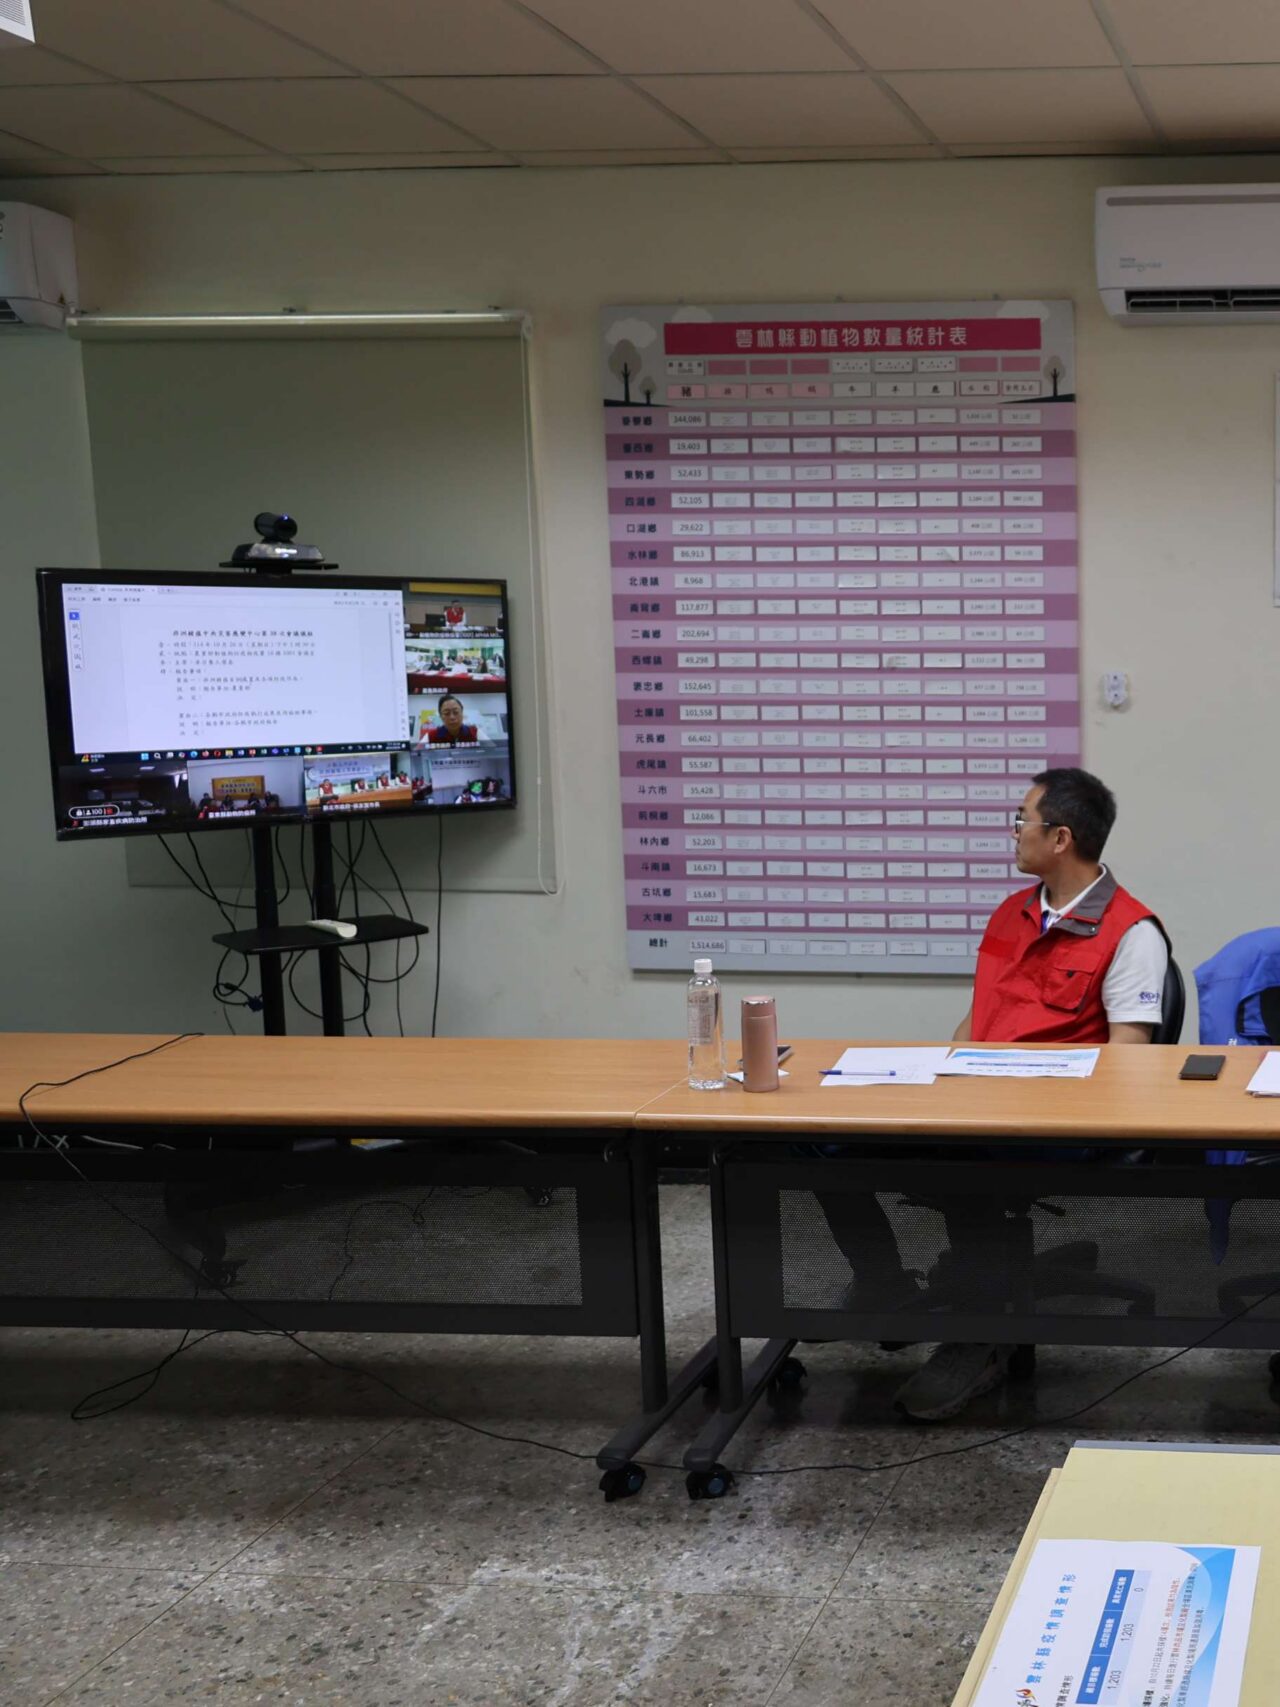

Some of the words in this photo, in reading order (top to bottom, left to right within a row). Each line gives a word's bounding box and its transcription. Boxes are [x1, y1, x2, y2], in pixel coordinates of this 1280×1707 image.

[735, 327, 967, 349] 雲林縣動植物數量統計表
[635, 733, 666, 743] 元長鄉
[636, 759, 667, 769] 虎尾鎮
[638, 785, 667, 795] 斗六市
[642, 887, 672, 897] 古坑鄉
[1025, 1573, 1077, 1684] 雲林縣疫情調查情形
[1107, 1670, 1122, 1690] 1,203
[1120, 1622, 1135, 1642] 1,203
